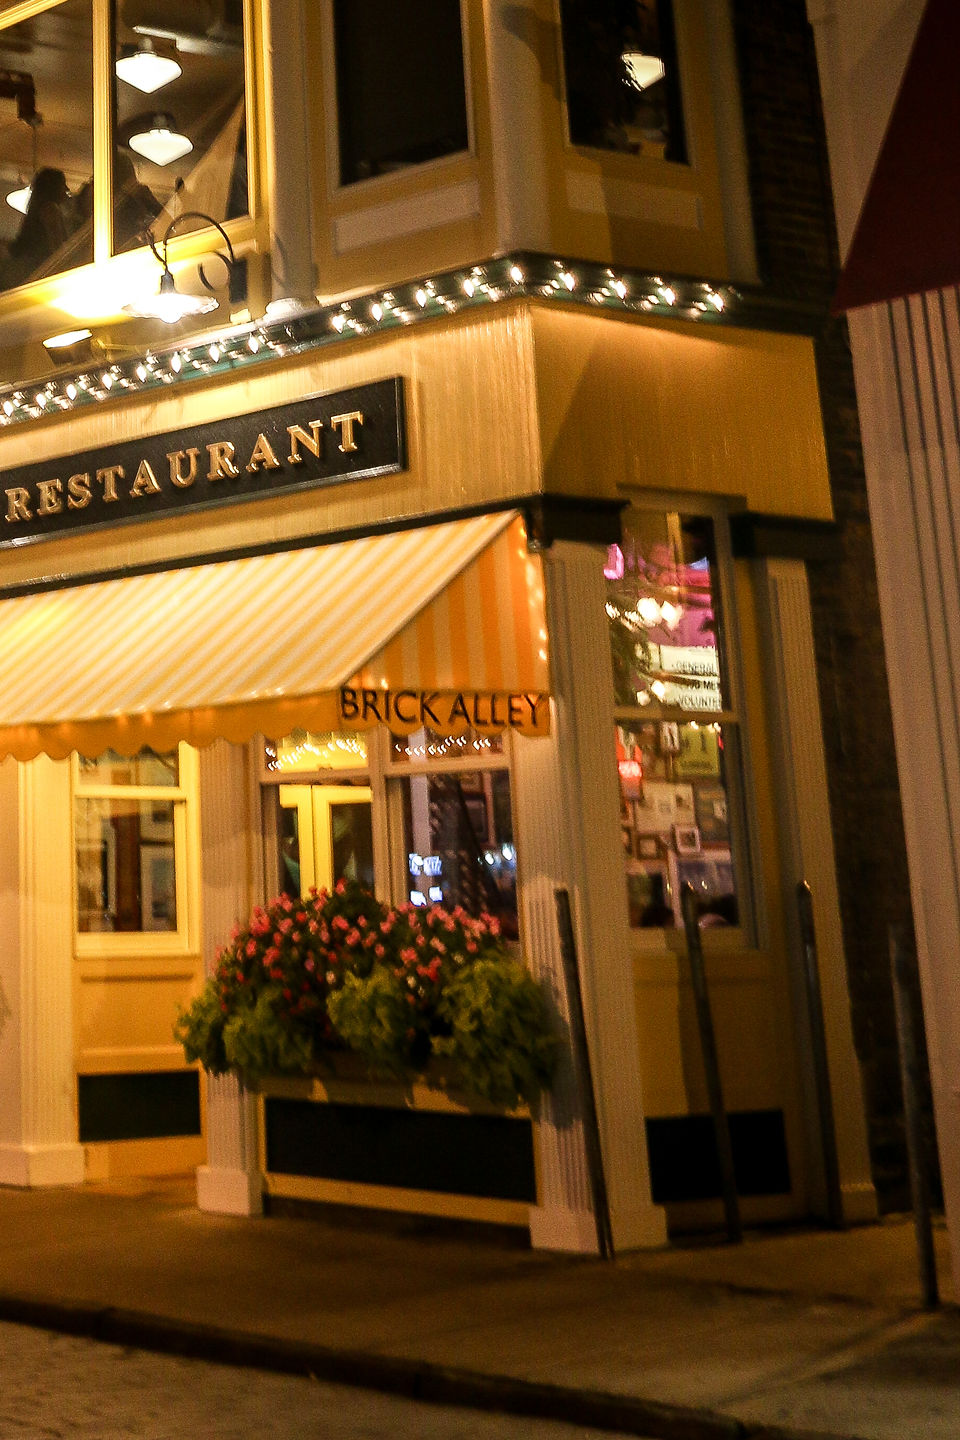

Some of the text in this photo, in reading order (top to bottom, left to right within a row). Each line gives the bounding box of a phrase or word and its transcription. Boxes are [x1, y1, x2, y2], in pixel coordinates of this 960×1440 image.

[5, 411, 363, 522] RESTAURANT
[340, 687, 543, 728] BRICK ALLEY
